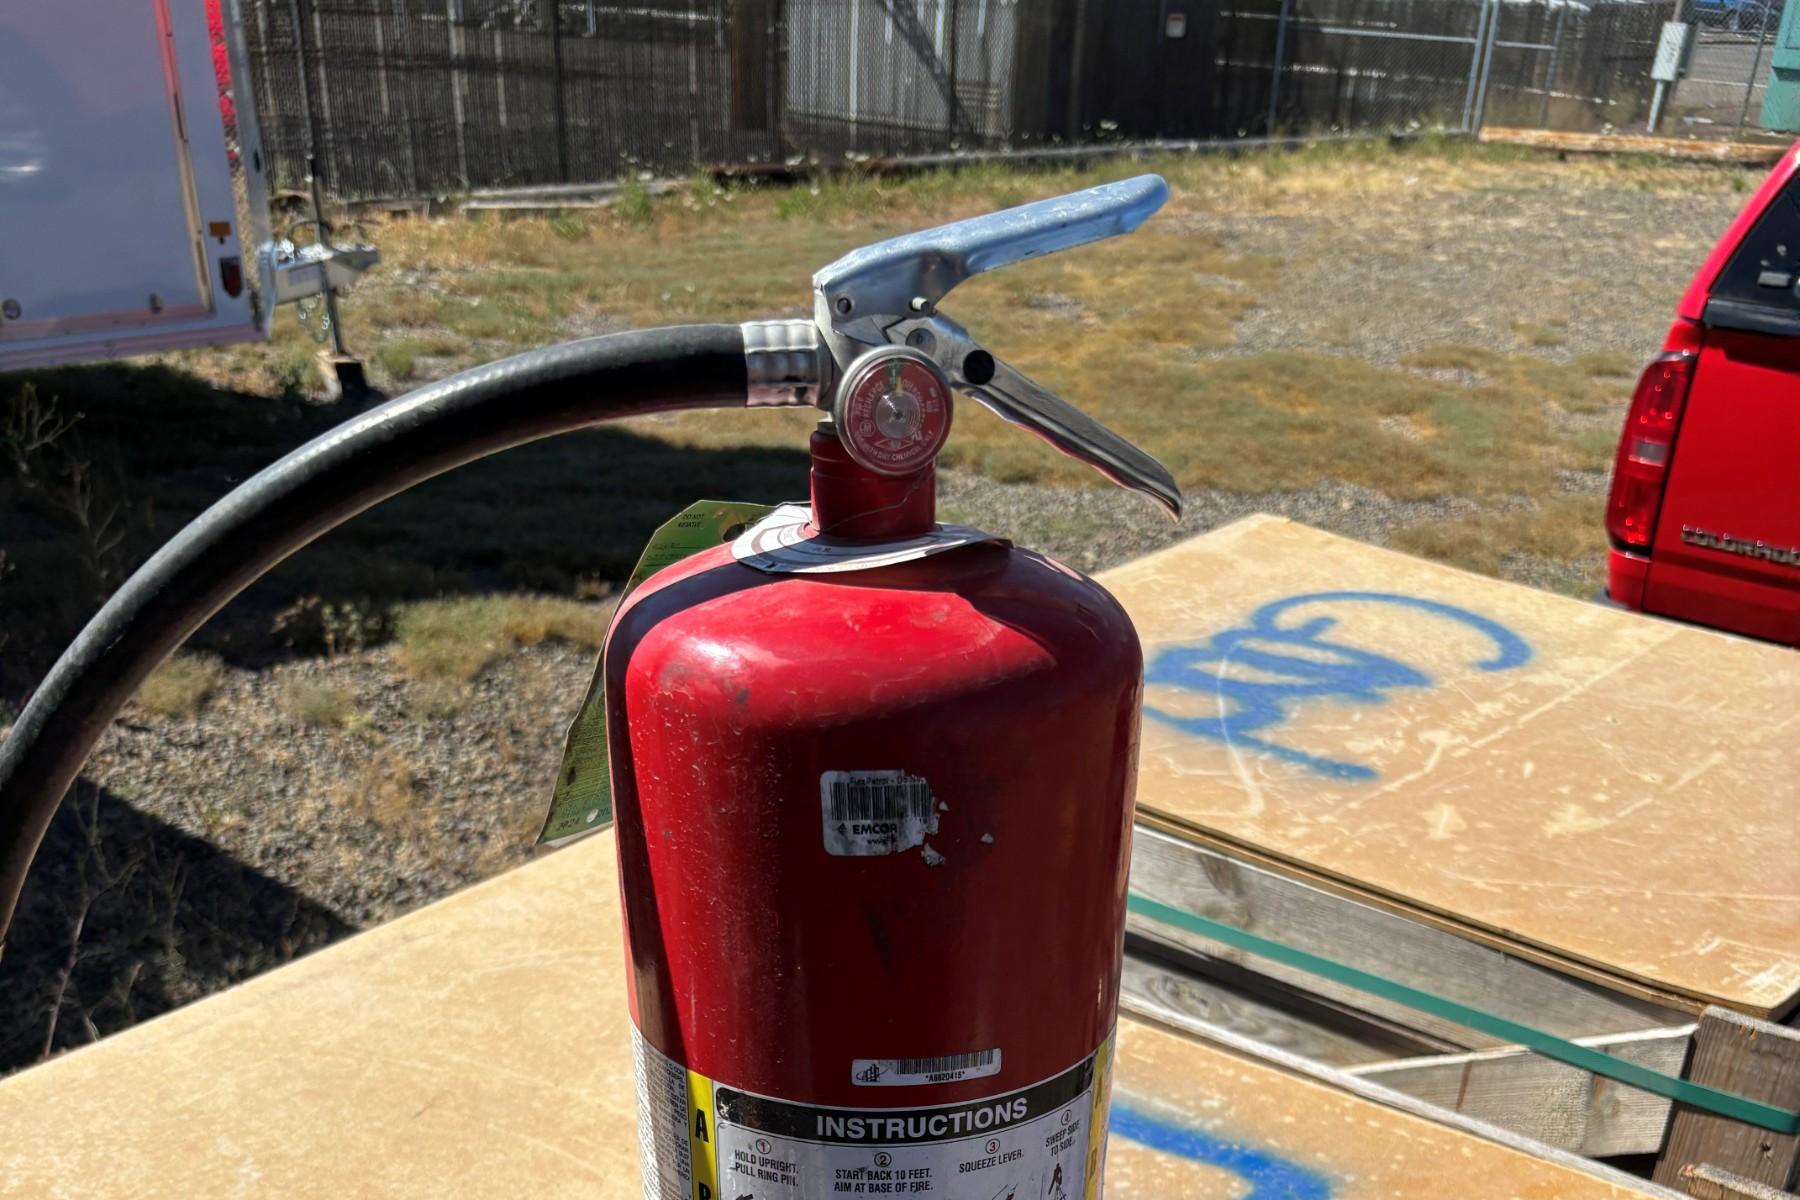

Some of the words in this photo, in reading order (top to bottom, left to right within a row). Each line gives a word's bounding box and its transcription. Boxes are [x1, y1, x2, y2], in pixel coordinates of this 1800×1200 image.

[852, 823, 898, 835] EMCOR
[695, 1108, 709, 1143] A
[816, 1099, 1028, 1138] INSTRUCTIONS
[1045, 1127, 1067, 1148] SWEEP
[1067, 1119, 1081, 1136] SIDE
[734, 1149, 757, 1165] HOLD
[758, 1156, 800, 1175] UPRIGHT.
[959, 1156, 997, 1174] SQUEEZE
[998, 1149, 1025, 1165] LEVER.
[1050, 1146, 1059, 1157] TO
[735, 1162, 757, 1177] PULL
[757, 1168, 779, 1183] RING
[780, 1174, 799, 1187] PIN.
[833, 1181, 852, 1193] AIM
[854, 1182, 866, 1193] AT
[868, 1182, 893, 1193] BASE
[894, 1182, 908, 1193] OF
[909, 1180, 934, 1193] FIRE.
[835, 1168, 865, 1181] START
[867, 1170, 893, 1181] BACK
[895, 1169, 906, 1180] 10
[908, 1167, 933, 1180] FEET.
